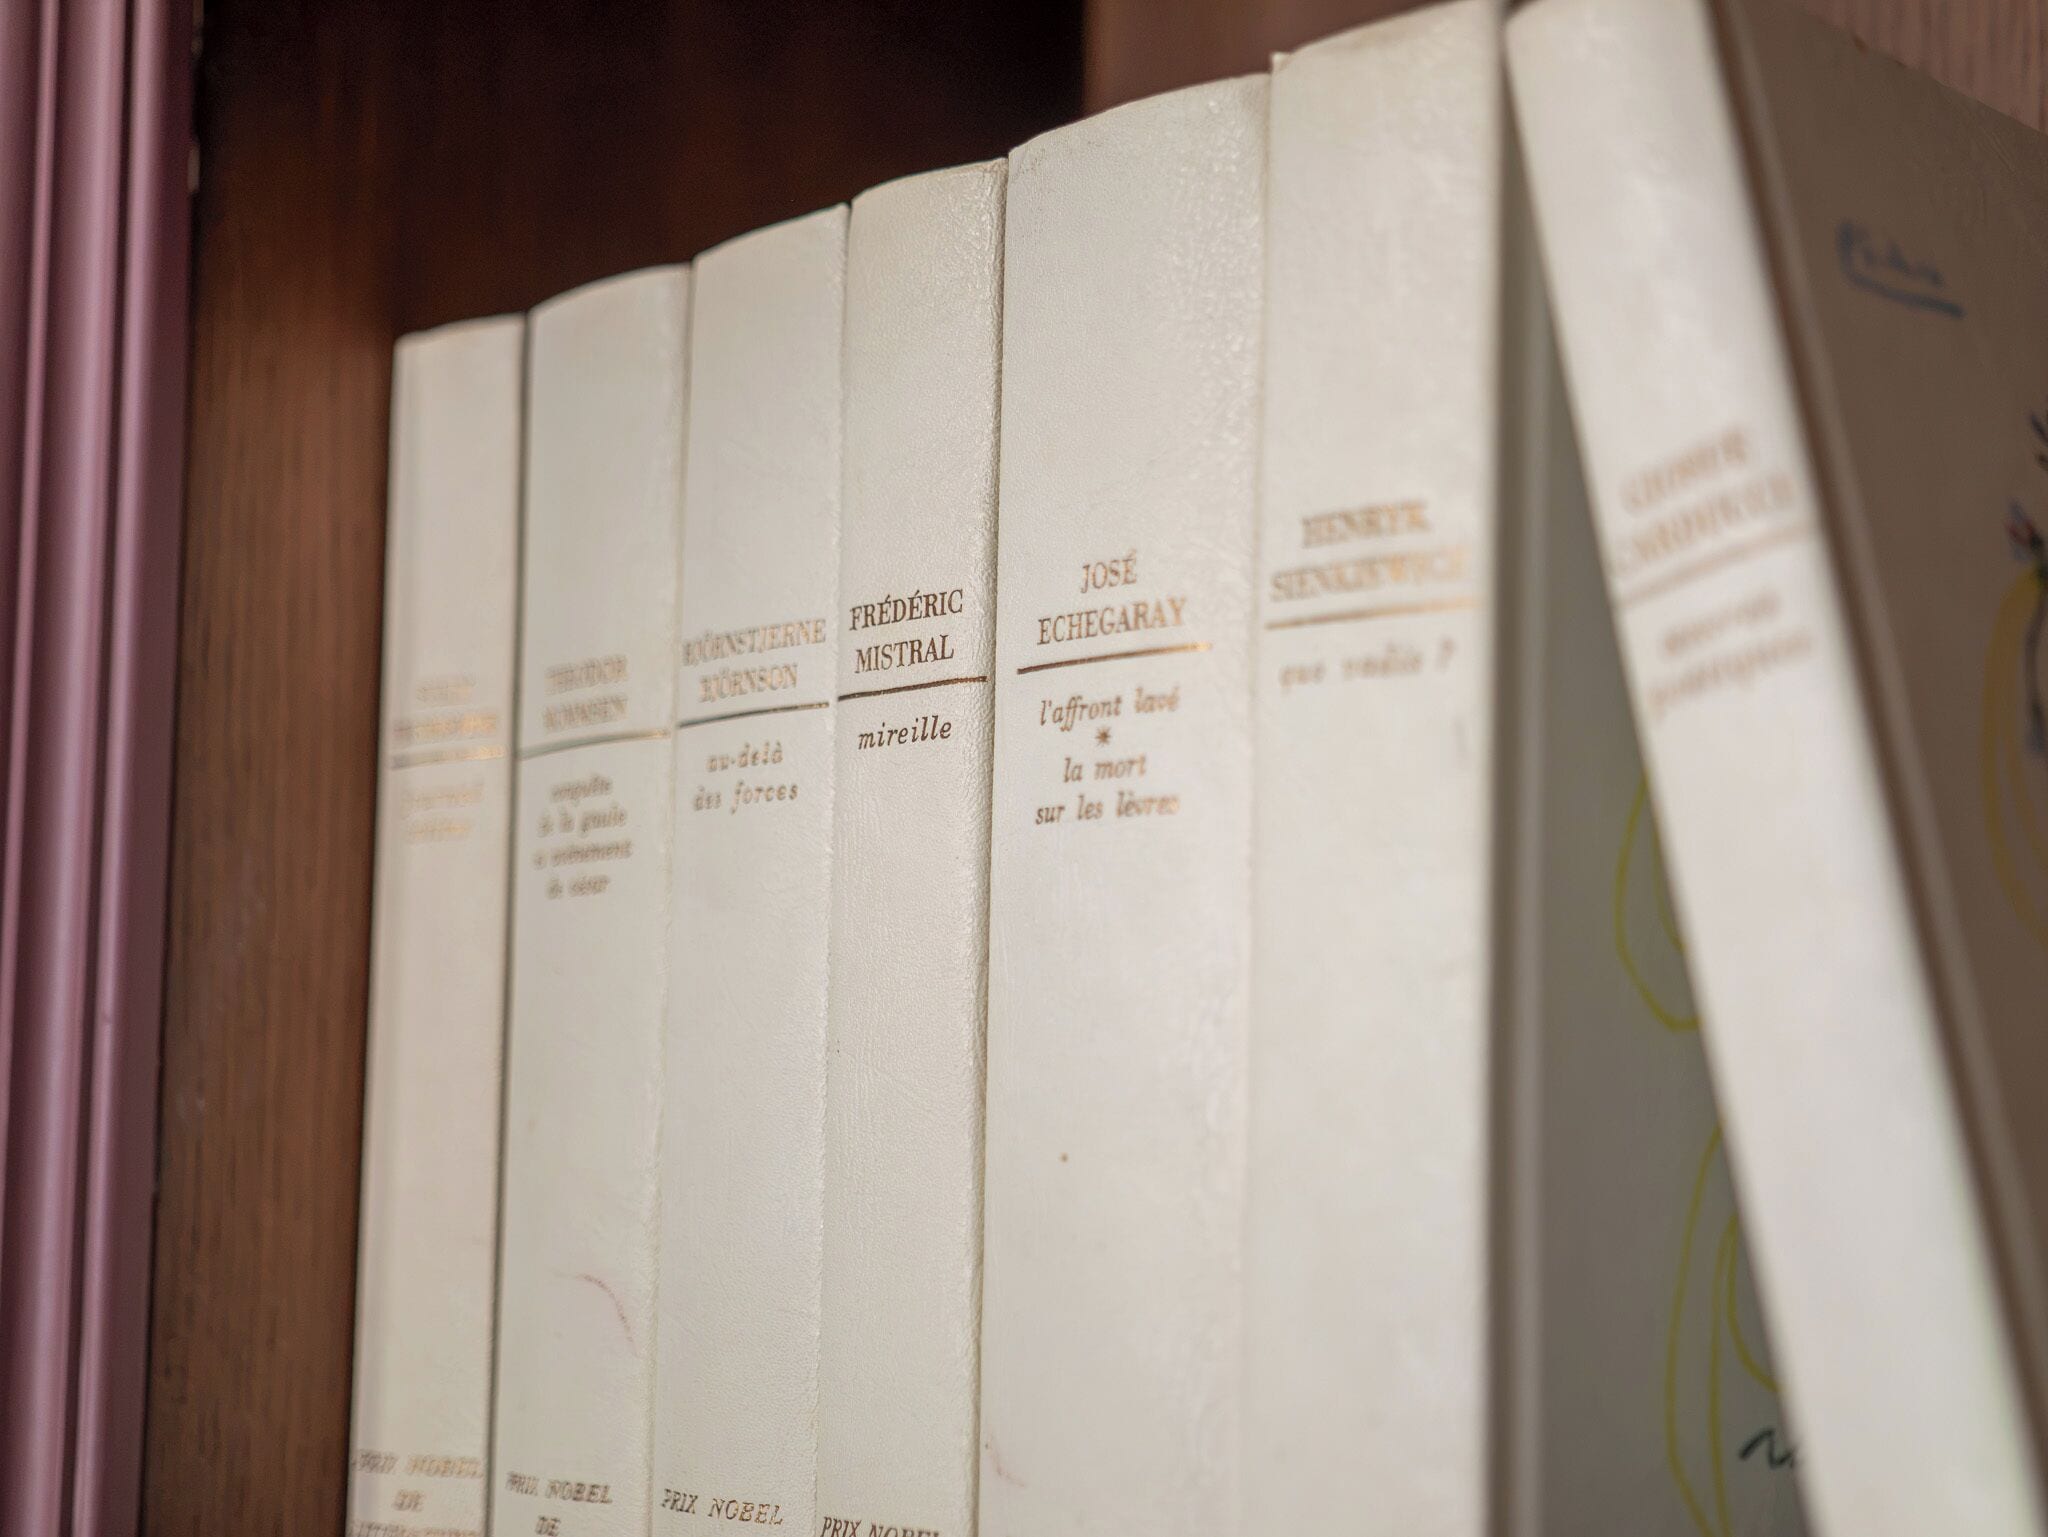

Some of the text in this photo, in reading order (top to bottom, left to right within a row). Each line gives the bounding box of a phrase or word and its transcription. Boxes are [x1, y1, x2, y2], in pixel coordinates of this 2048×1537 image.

[1081, 550, 1138, 594] JOSÉ
[849, 589, 964, 631] FRÉDÉRIC
[1036, 596, 1188, 645] ECHEGARAY
[854, 634, 955, 674] MISTRAL
[1039, 693, 1122, 732] l'affront
[857, 715, 952, 750] mireille
[1063, 754, 1147, 783] la mort
[730, 779, 798, 815] forces
[1035, 805, 1065, 825] sur
[1076, 794, 1104, 821] les
[545, 1480, 613, 1503] NOBEL
[661, 1488, 783, 1525] PRIX NOBEL
[535, 1515, 560, 1536] DE
[820, 1516, 862, 1537] PRIX
